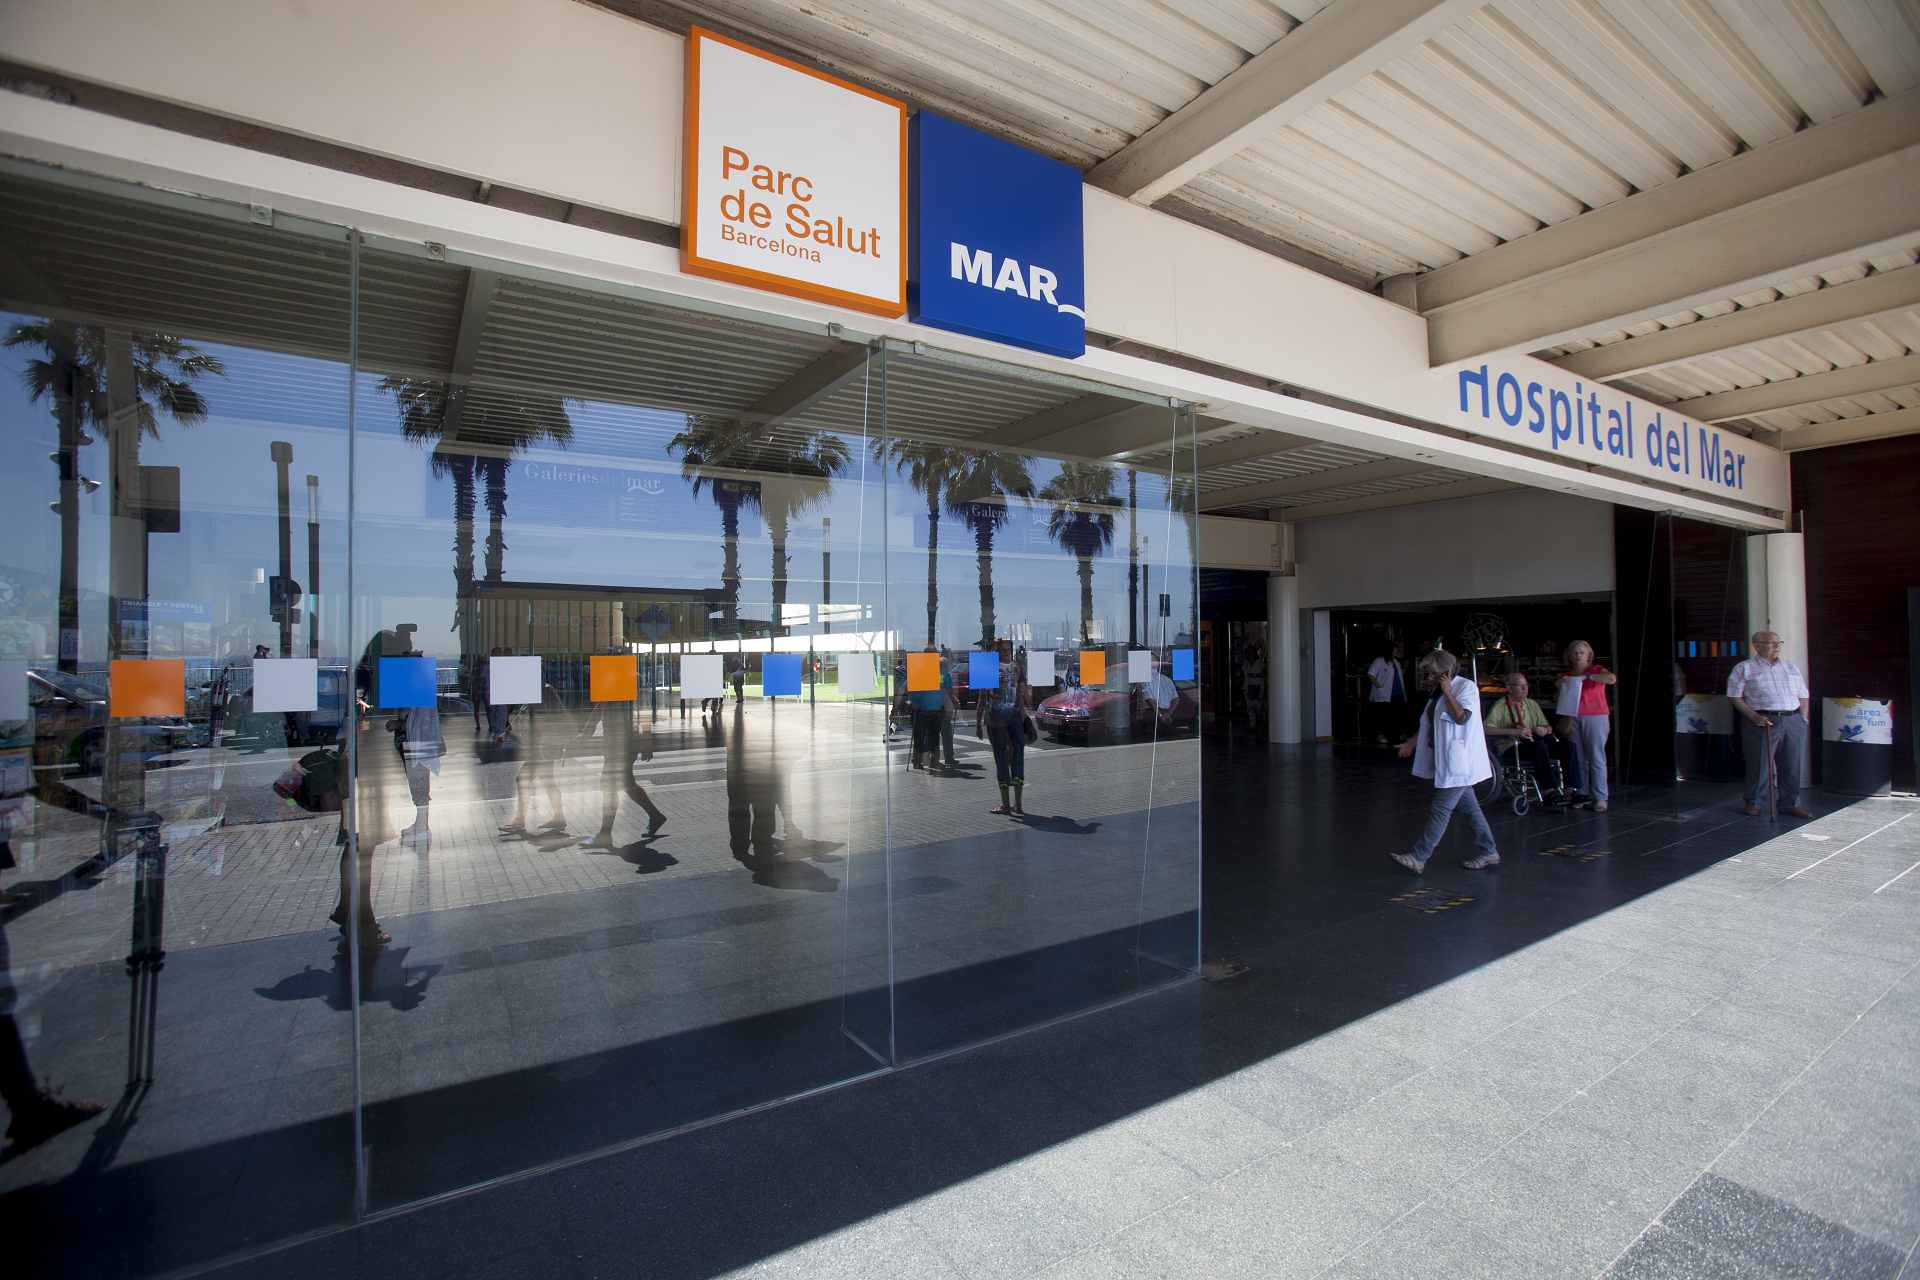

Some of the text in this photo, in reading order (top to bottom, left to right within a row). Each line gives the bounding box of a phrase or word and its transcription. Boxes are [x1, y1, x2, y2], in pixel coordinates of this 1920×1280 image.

[722, 145, 814, 202] Parc
[720, 189, 881, 258] de Salut
[721, 223, 822, 264] Barcelona
[950, 241, 1059, 307] MAR
[1458, 364, 1746, 490] Hospital del Mar
[122, 600, 162, 608] TRIANGLE
[1845, 713, 1869, 721] sense
[1867, 718, 1886, 727] fum
